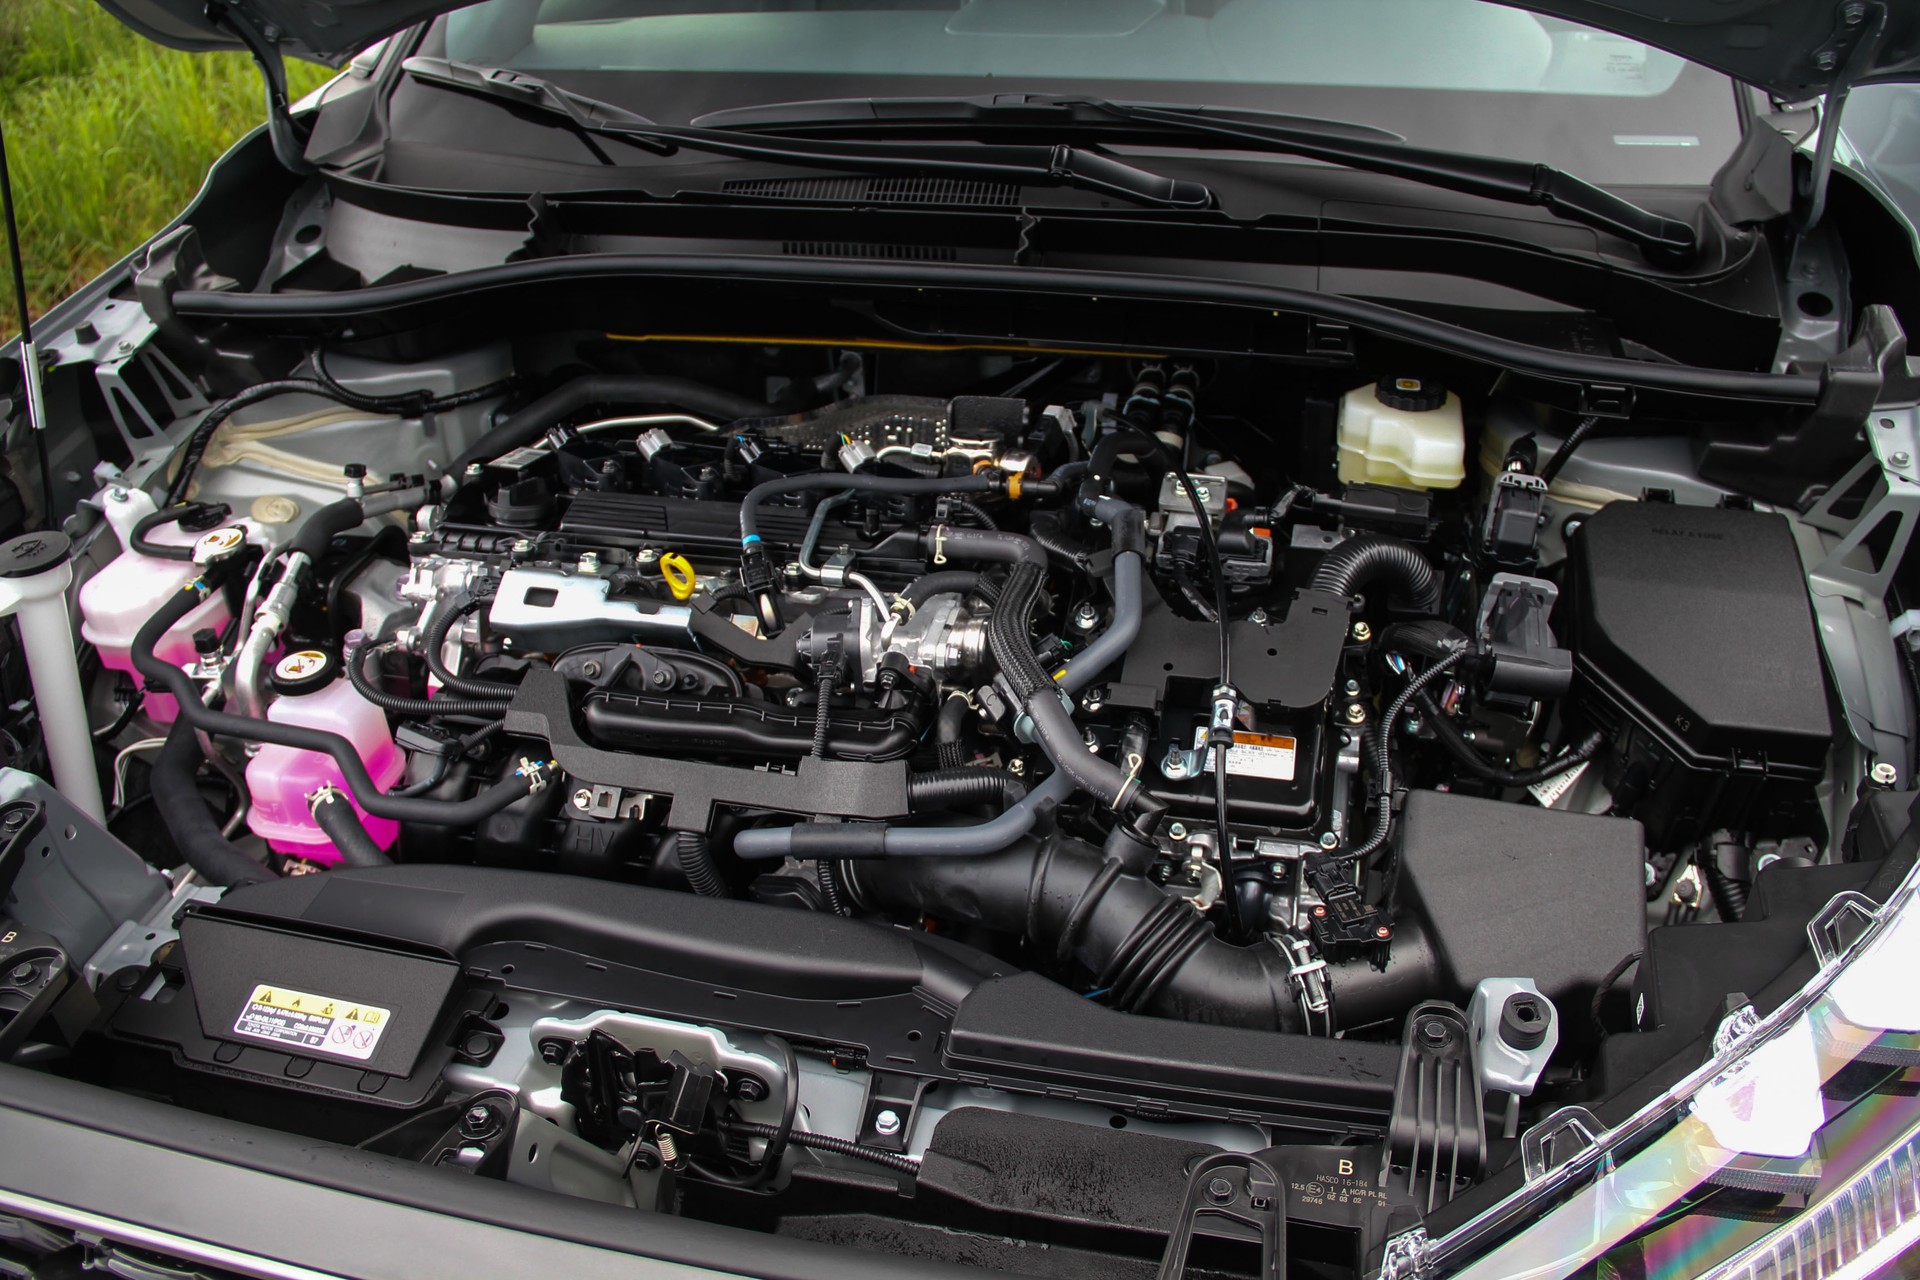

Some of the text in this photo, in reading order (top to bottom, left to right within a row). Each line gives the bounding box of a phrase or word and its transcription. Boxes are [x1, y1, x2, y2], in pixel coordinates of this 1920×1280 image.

[575, 824, 615, 855] HV
[1, 931, 17, 943] B
[1338, 1159, 1353, 1175] B
[1291, 1182, 1305, 1190] 12.5
[1316, 1174, 1368, 1187] HASCO 16-184
